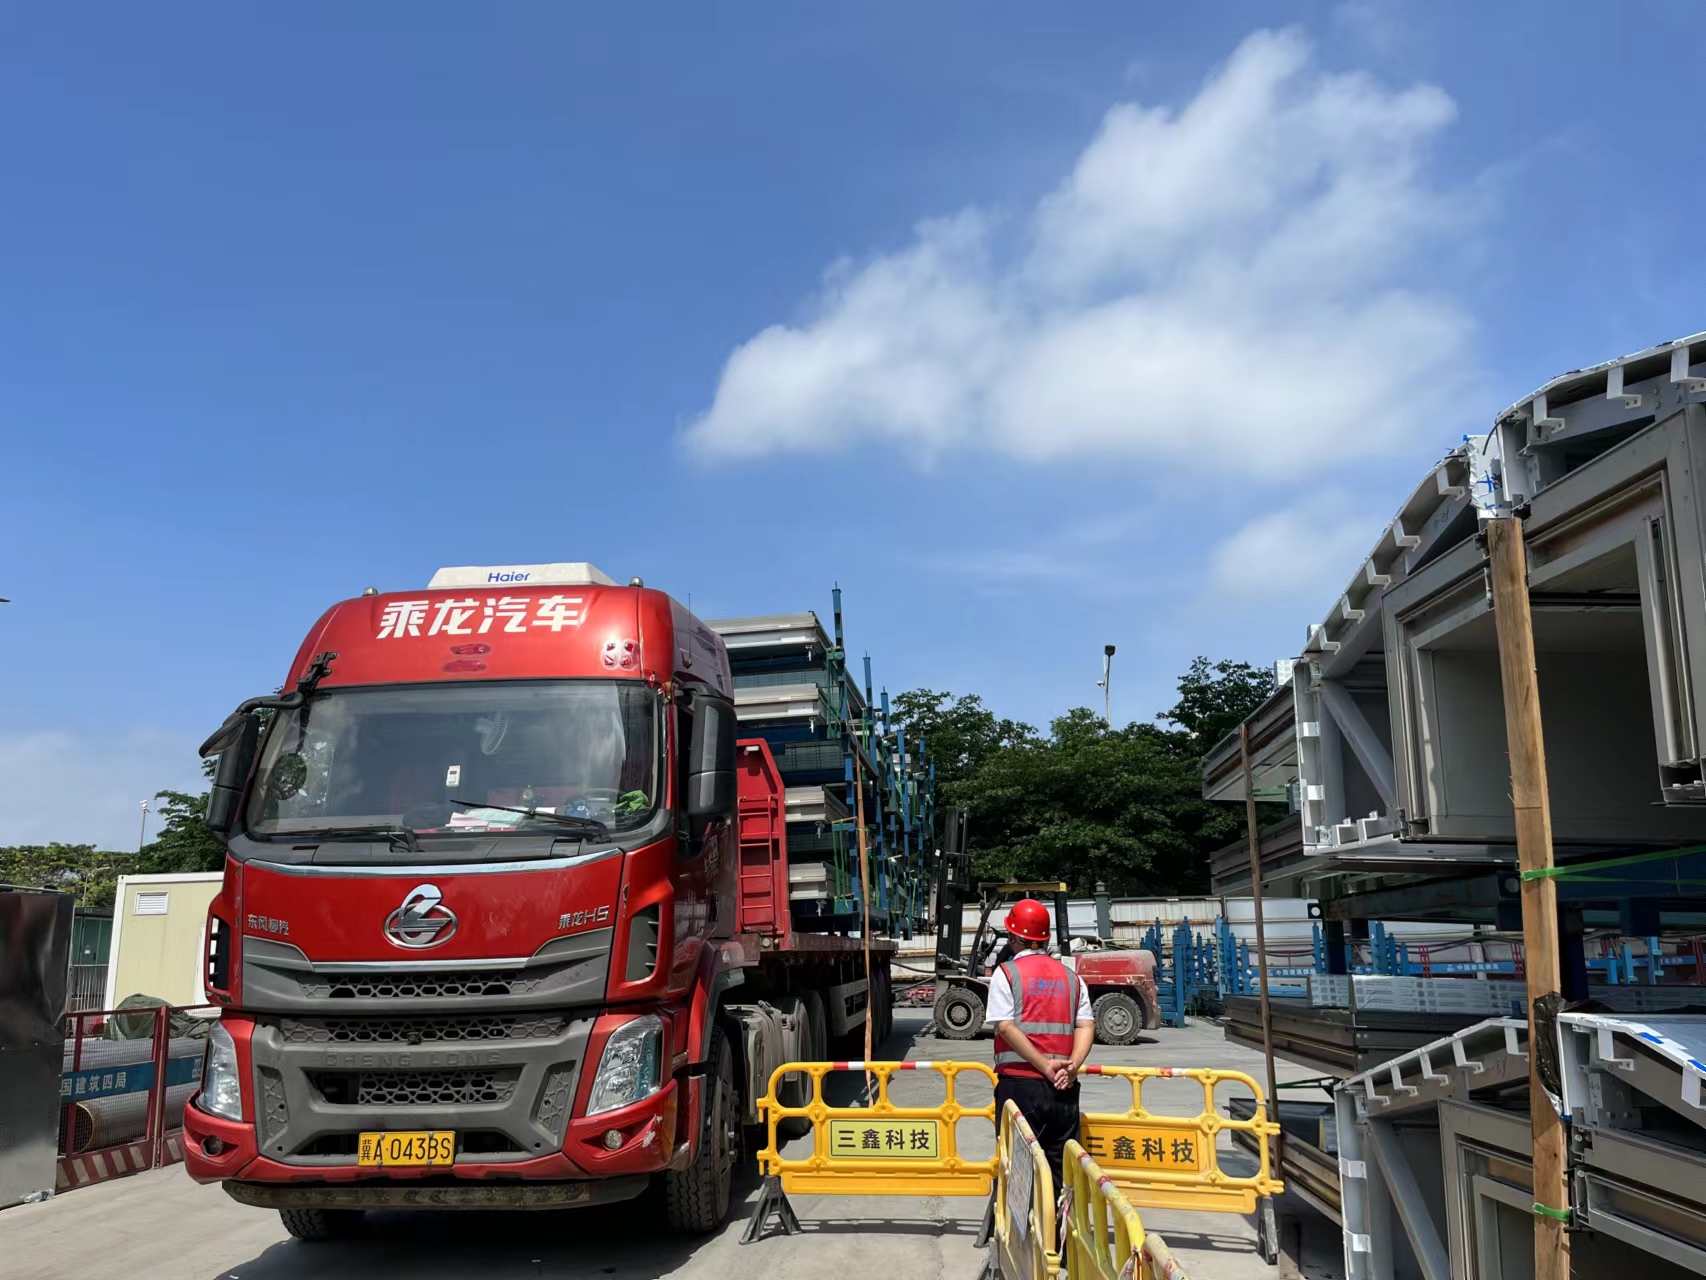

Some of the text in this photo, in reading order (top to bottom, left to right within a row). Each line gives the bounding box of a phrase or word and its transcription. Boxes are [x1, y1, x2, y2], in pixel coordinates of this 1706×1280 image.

[487, 571, 530, 583] Haier
[376, 594, 583, 639] 乘龙汽车
[837, 1129, 930, 1150] 三鑫科技
[1085, 1135, 1195, 1163] 三鑫科技
